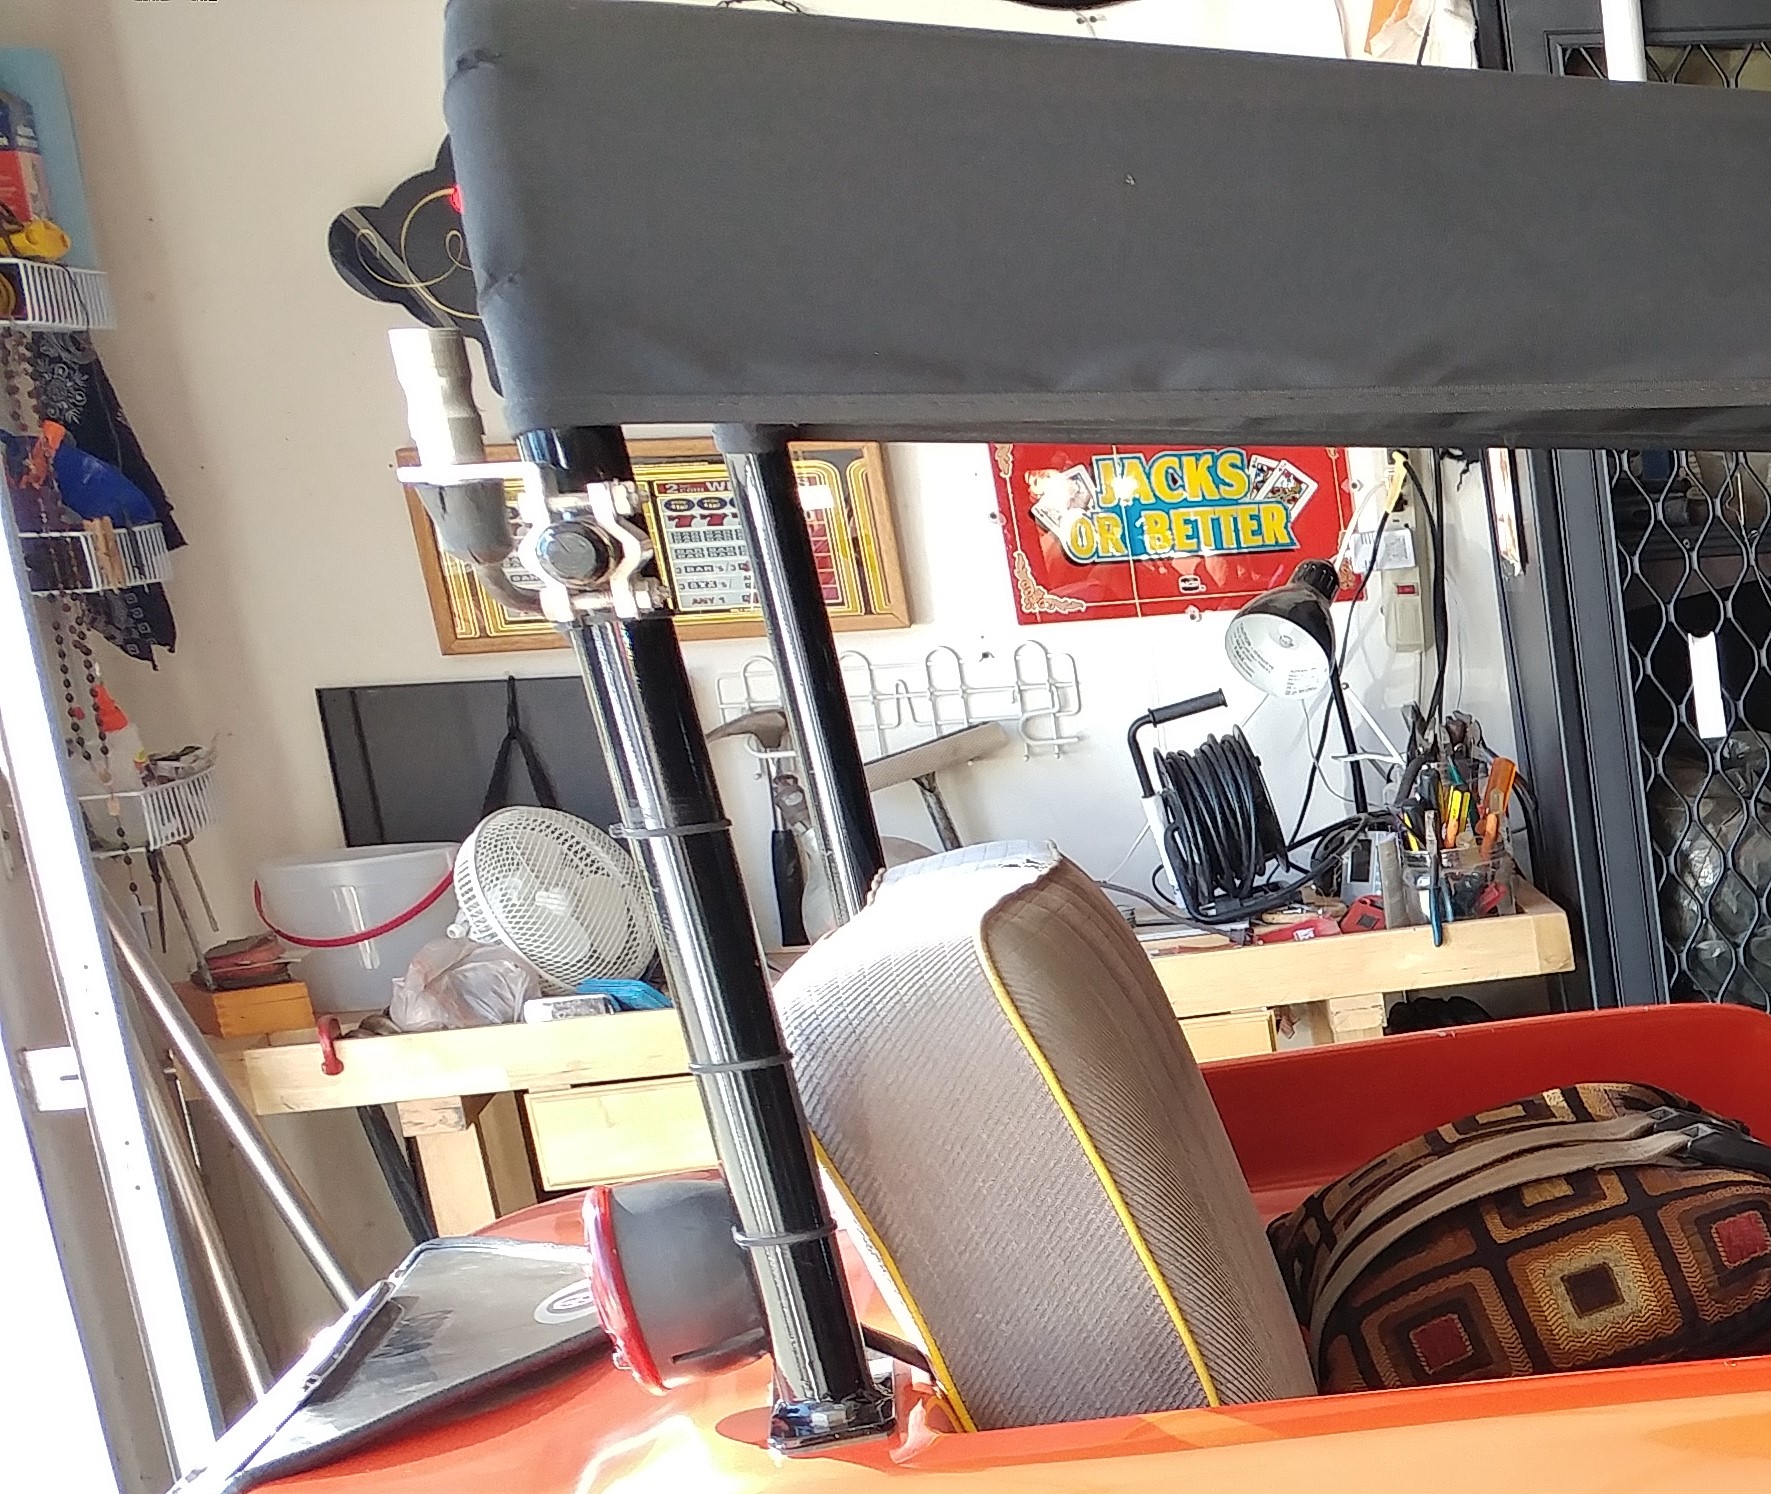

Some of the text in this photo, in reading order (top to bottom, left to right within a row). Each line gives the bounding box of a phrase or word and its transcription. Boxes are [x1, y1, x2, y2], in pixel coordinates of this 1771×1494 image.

[1099, 451, 1248, 504] JACKS
[1069, 502, 1291, 557] OR BETTER
